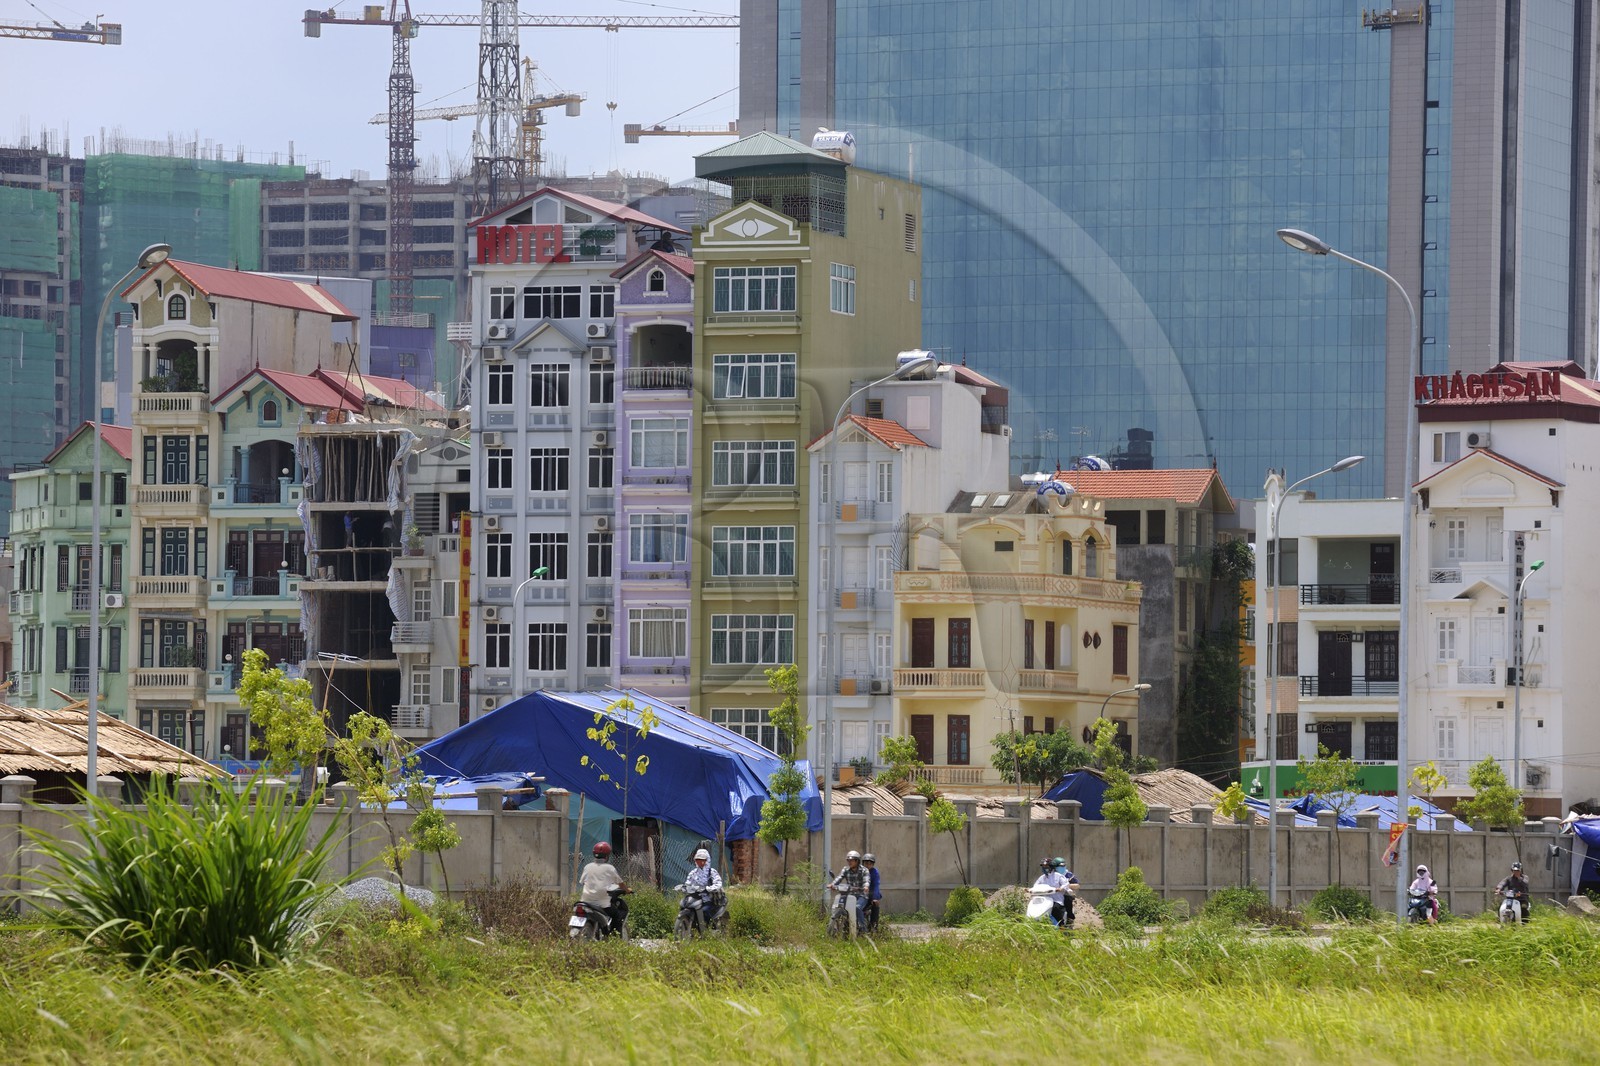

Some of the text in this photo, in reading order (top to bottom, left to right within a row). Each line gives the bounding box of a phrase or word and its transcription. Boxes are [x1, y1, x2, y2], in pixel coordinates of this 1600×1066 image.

[477, 225, 571, 264] HOTEL
[1414, 370, 1561, 402] KHÁCH SẠN
[462, 519, 471, 657] HOTEL
